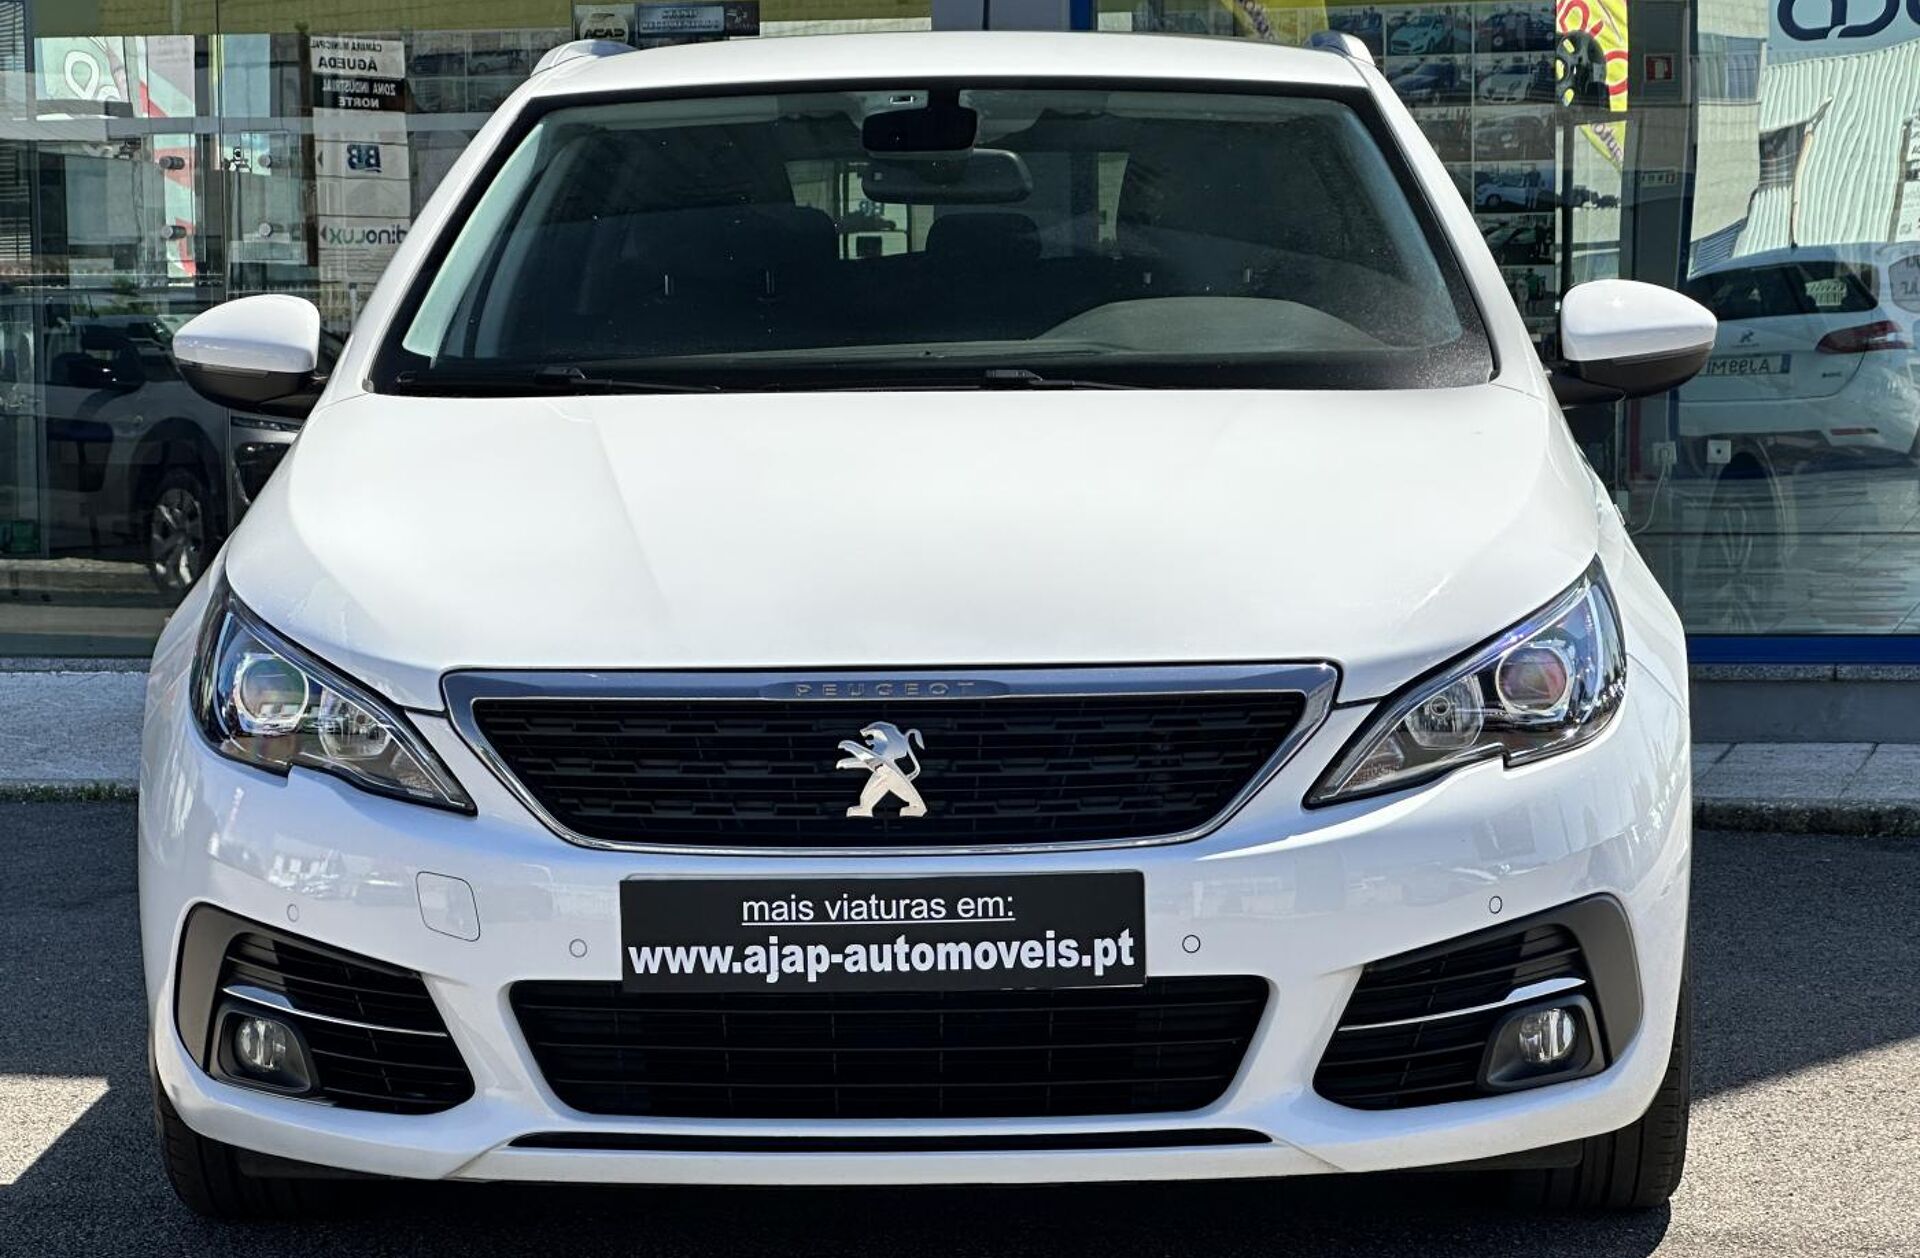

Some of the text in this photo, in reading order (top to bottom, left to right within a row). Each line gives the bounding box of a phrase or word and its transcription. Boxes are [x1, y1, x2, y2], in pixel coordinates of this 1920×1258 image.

[795, 681, 975, 697] PEUGEOT
[742, 893, 1016, 921] mais viaturas em:
[628, 928, 1136, 982] www.ajap-automoveis.pt
